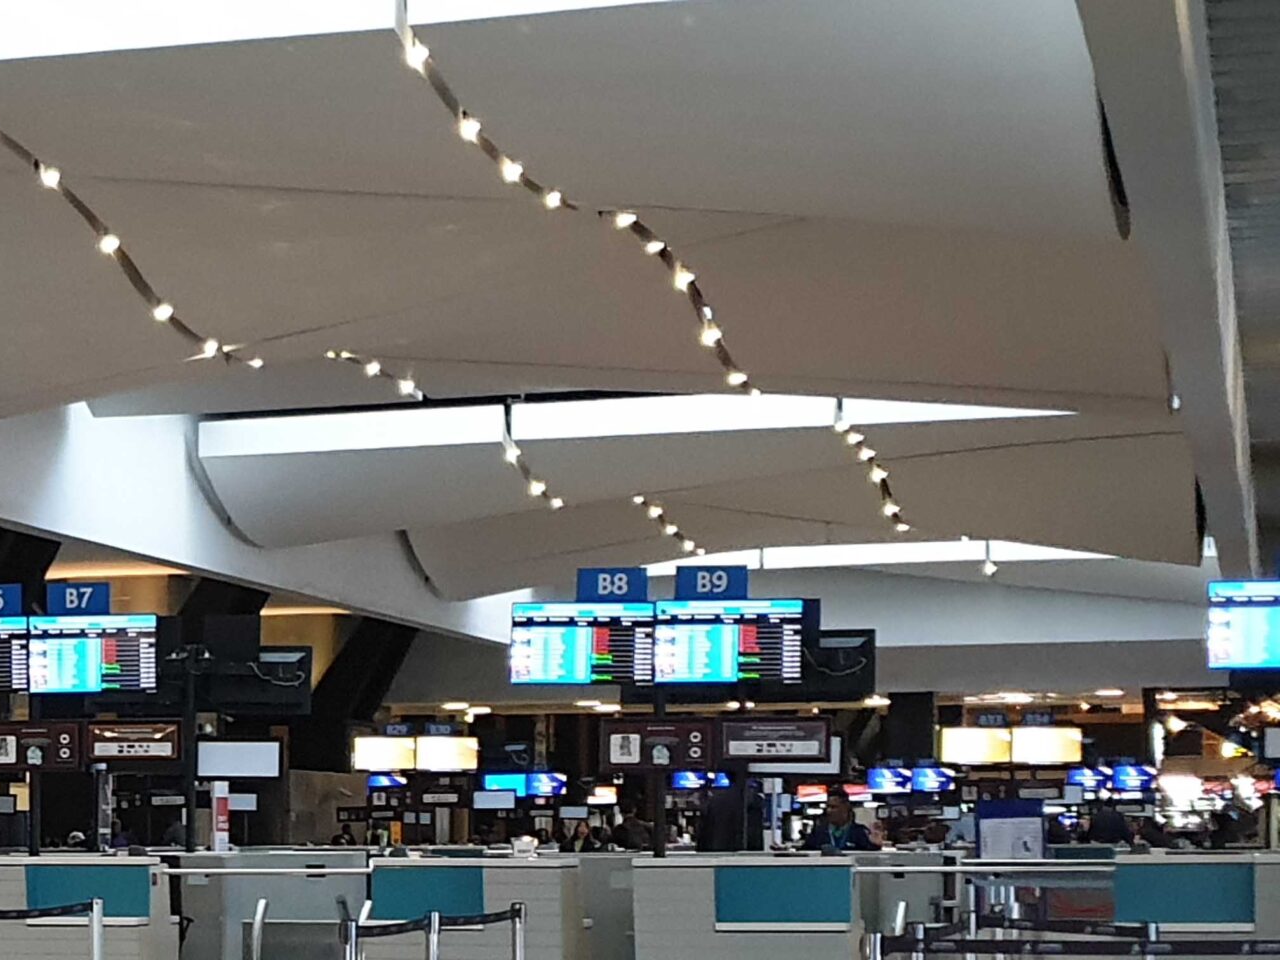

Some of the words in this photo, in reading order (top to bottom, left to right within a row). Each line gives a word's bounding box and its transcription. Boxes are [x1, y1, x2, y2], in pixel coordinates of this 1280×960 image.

[597, 573, 629, 595] B8
[696, 571, 728, 593] B9
[65, 588, 93, 608] B7
